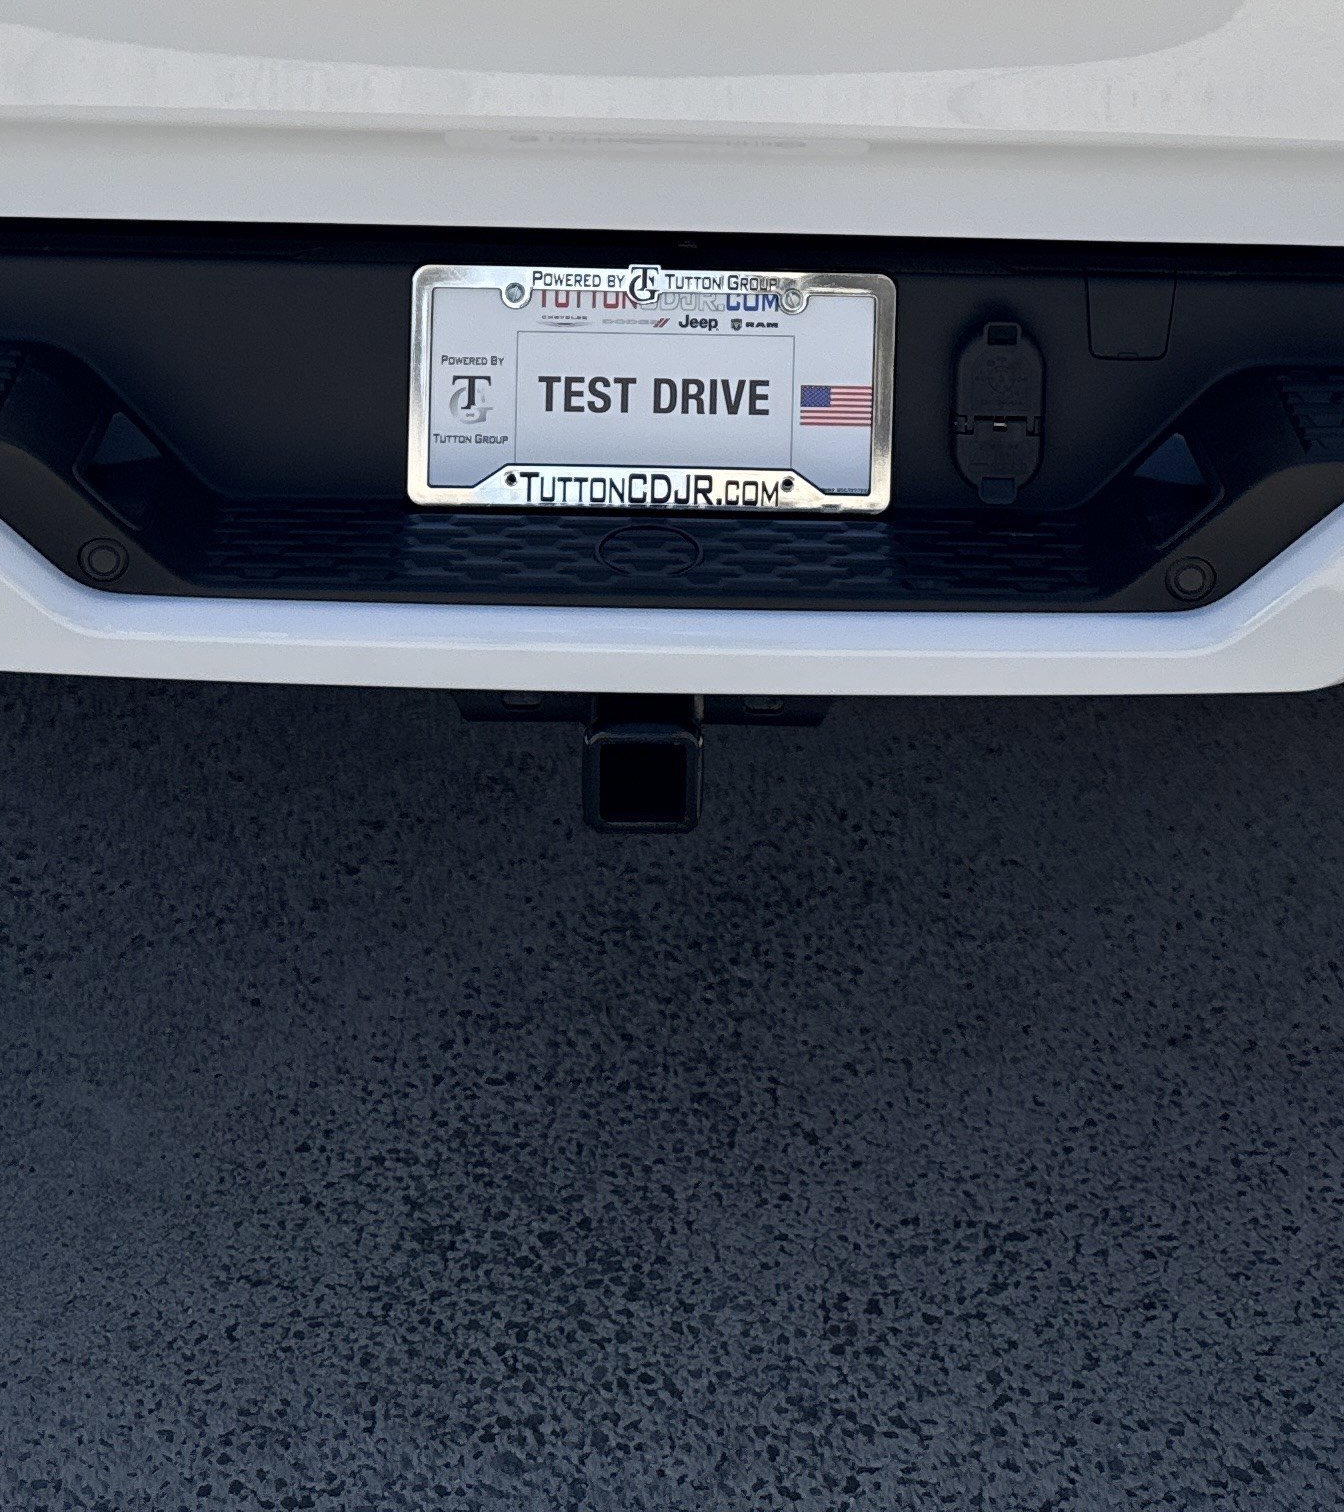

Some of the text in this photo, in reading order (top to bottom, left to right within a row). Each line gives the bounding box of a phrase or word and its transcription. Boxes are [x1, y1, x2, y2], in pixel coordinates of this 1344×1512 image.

[533, 271, 601, 288] POWERED
[607, 275, 625, 288] BY
[665, 274, 723, 290] TUTTON
[727, 275, 778, 292] GROUP
[679, 315, 717, 331] Jeep
[441, 355, 505, 366] POWERED BY
[538, 375, 770, 416] TEST DRIVE
[433, 433, 509, 445] TUTTON GROUP
